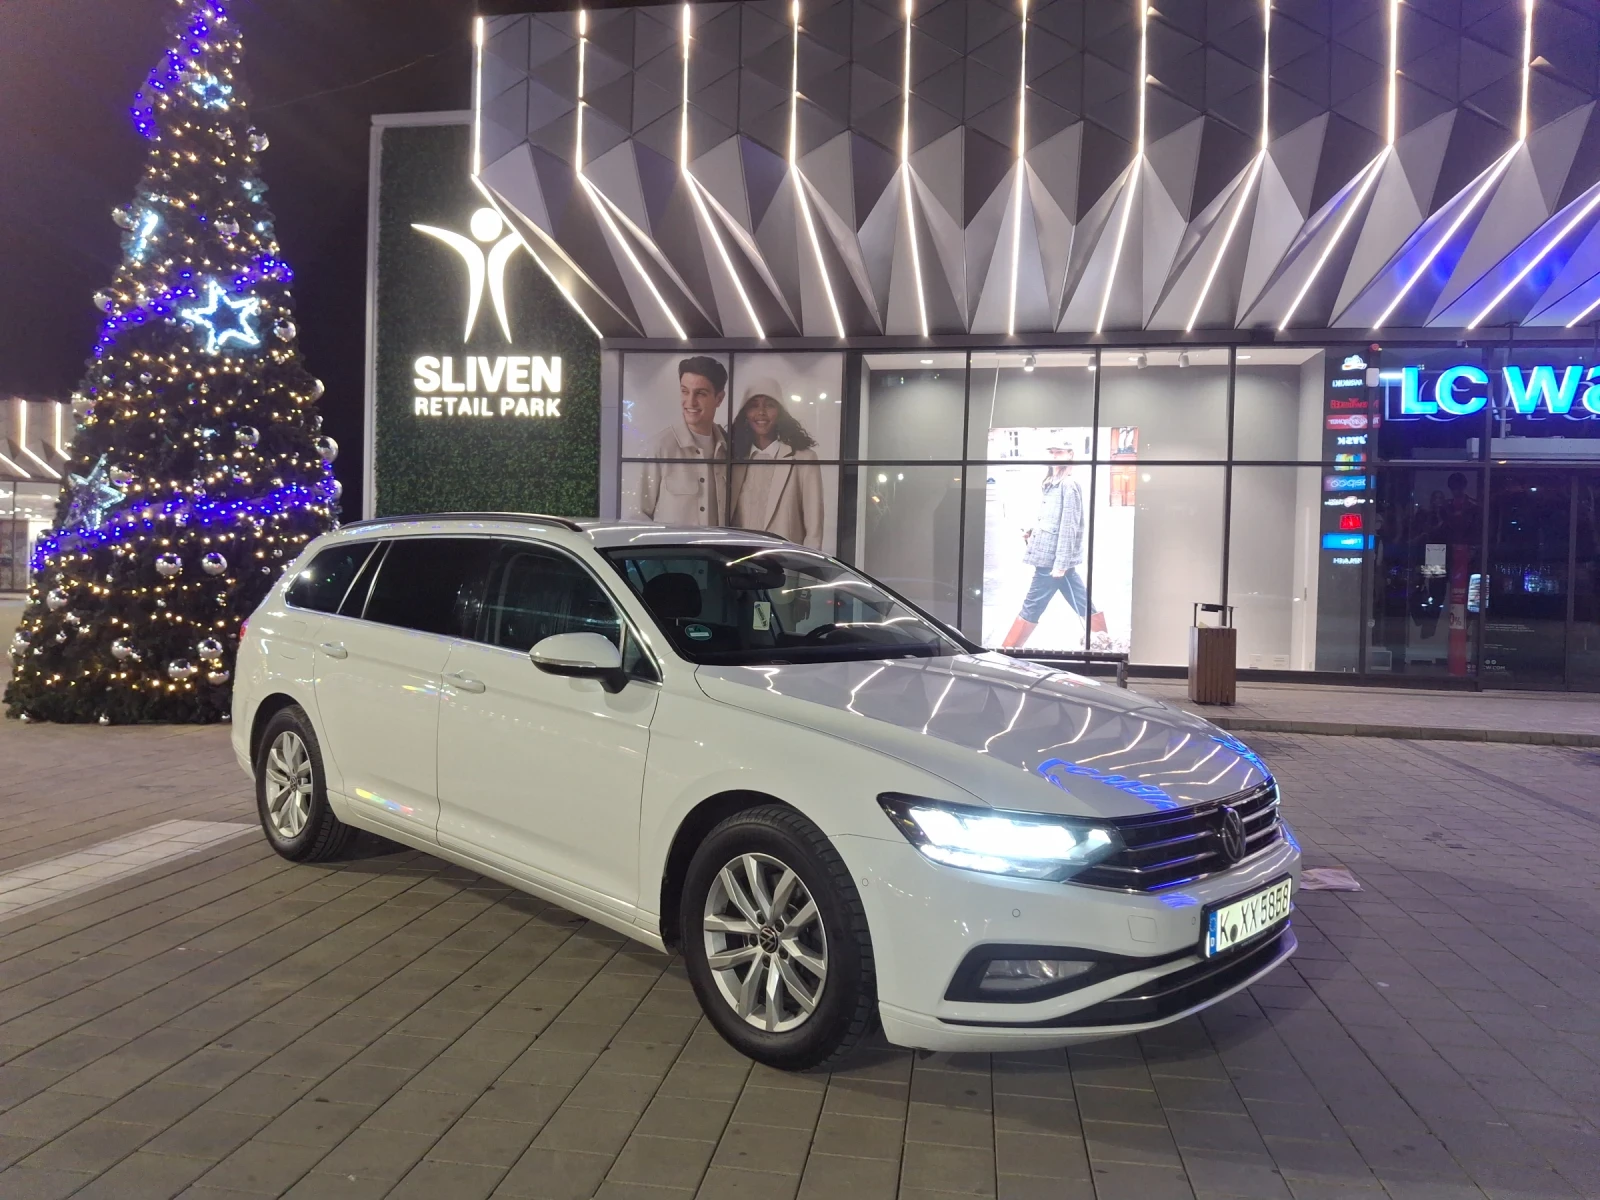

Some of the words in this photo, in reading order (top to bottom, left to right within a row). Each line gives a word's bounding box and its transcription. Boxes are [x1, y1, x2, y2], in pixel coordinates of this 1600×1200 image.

[413, 355, 562, 393] SLIVEN
[1400, 365, 1489, 415] LC
[414, 396, 493, 417] RETAIL
[500, 397, 561, 417] PARK
[1220, 910, 1230, 946] K
[1240, 898, 1260, 937] XX
[1260, 884, 1289, 925] 5858
